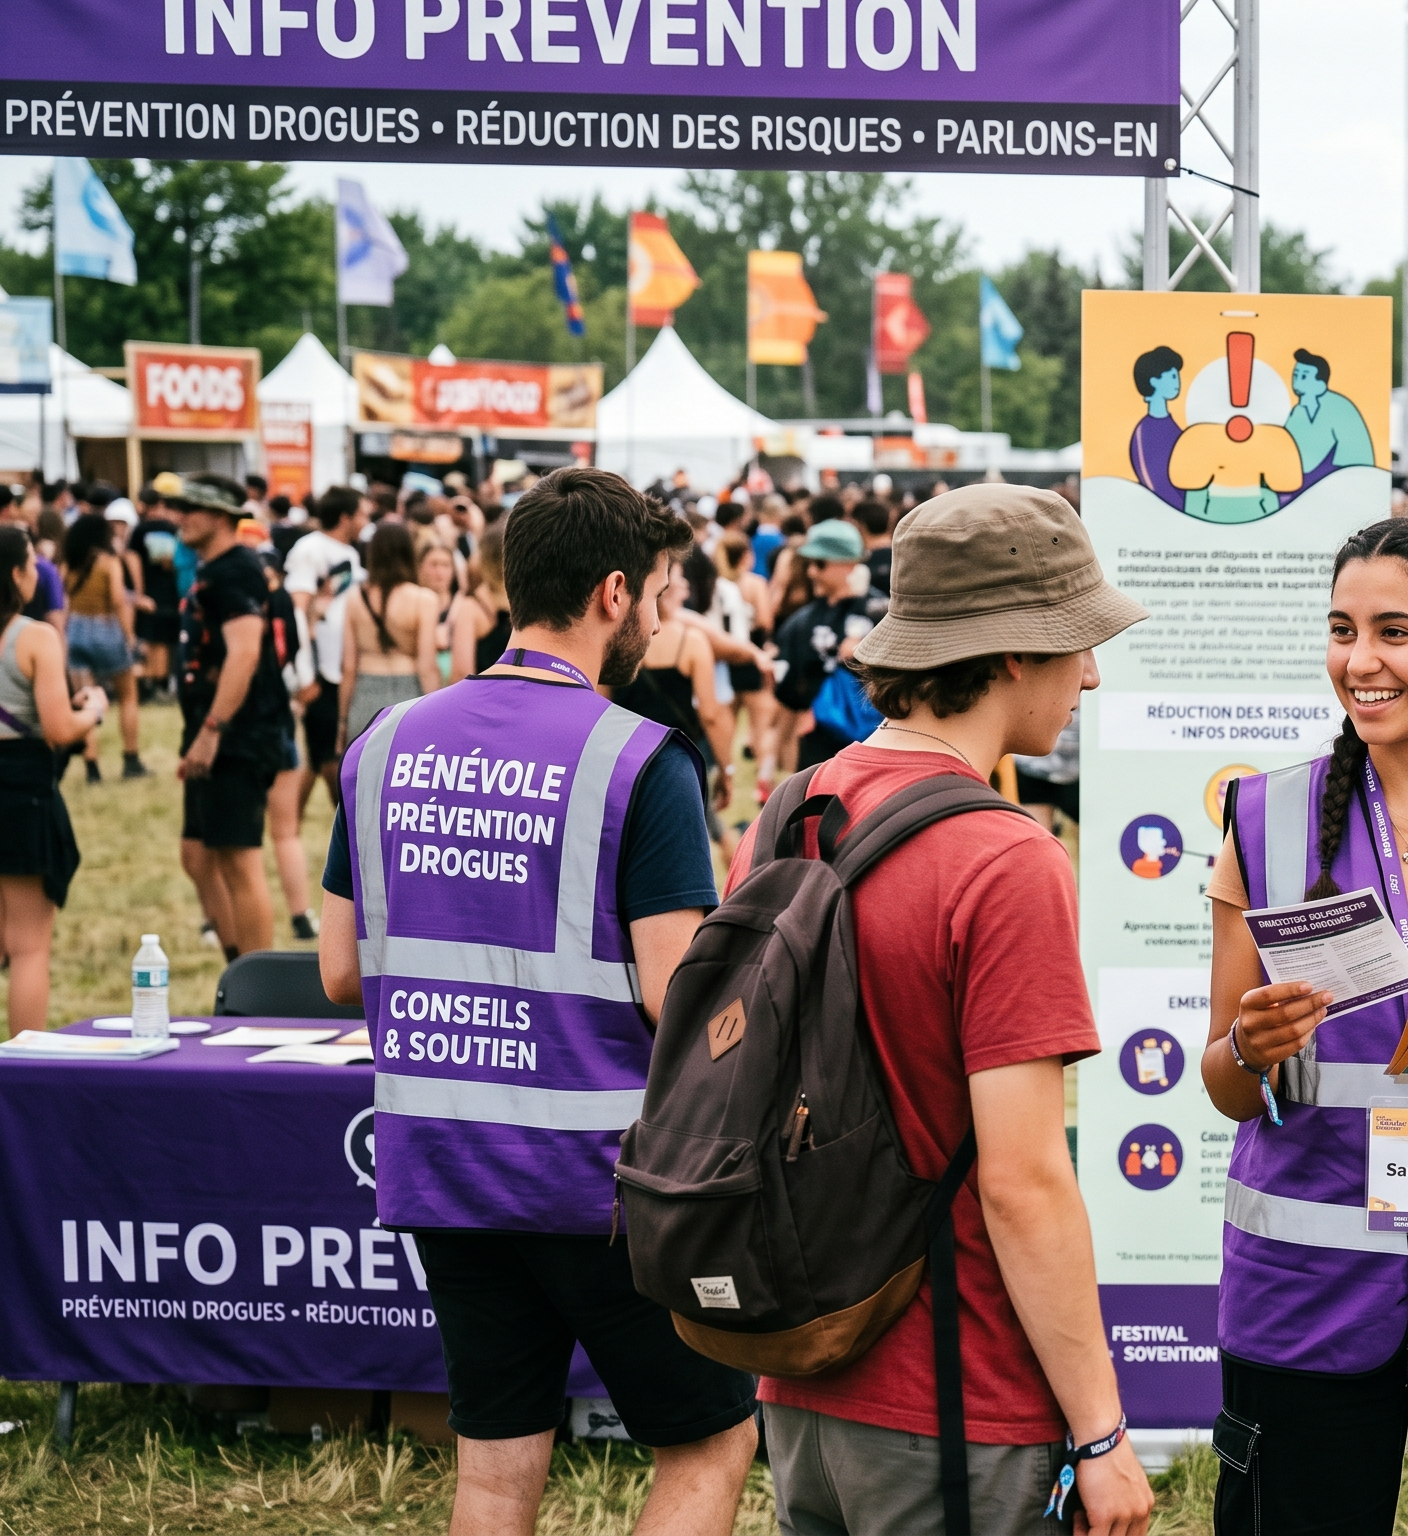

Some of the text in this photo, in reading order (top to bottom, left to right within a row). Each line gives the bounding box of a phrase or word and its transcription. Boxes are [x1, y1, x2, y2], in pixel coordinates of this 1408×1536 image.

[165, 0, 376, 60] INFO
[5, 90, 236, 140] PRÉVENTION
[248, 104, 420, 144] DROGUES
[456, 101, 660, 149] RÉDUCTION
[672, 114, 741, 150] DES
[751, 115, 902, 156] RISQUES
[937, 118, 1158, 158] PARLONS-EN
[1147, 702, 1330, 720] RÉDUCTION DES RISQUES
[1182, 726, 1226, 739] INFOS
[1229, 726, 1300, 740] DROGUES
[389, 744, 567, 802] BÉNÉVOLE
[386, 797, 556, 846] PRÉVENTION
[399, 842, 529, 884] DROGUES
[389, 989, 531, 1031] CONSEILS
[383, 1029, 538, 1071] & SOUTIEN
[61, 1219, 237, 1286] INFO
[62, 1294, 187, 1319] PRÉVENTION
[192, 1300, 286, 1322] DROGUES
[305, 1300, 417, 1327] RÉDUCTION
[1111, 1325, 1189, 1342] FESTIVAL
[1123, 1345, 1219, 1363] SOVENTION
